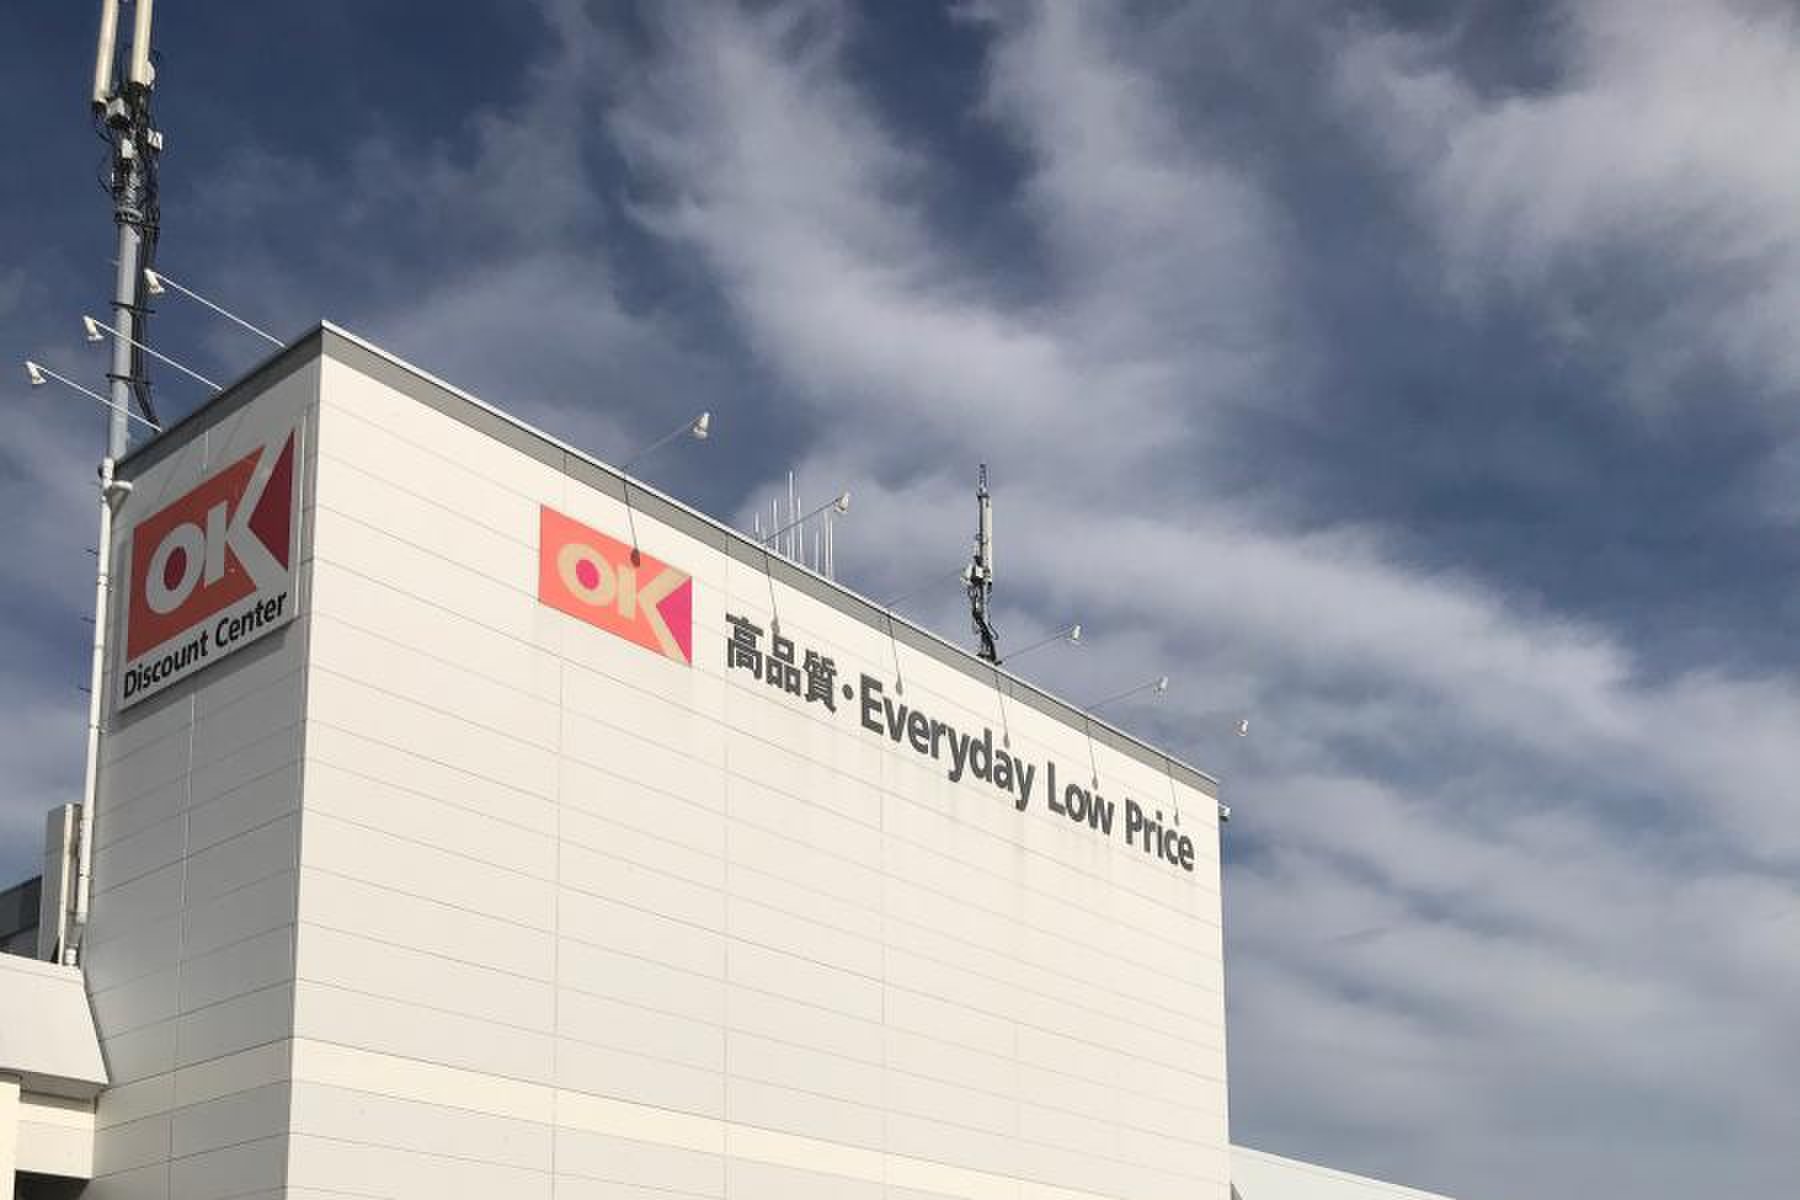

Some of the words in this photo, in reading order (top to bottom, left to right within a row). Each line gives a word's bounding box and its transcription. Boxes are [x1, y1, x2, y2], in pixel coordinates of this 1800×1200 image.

[140, 430, 294, 615] OK
[123, 630, 209, 699] Discount
[215, 592, 287, 648] Center
[556, 540, 692, 666] OK
[860, 673, 1035, 812] Everyday
[1047, 761, 1115, 836] Low
[1125, 798, 1195, 872] Price
